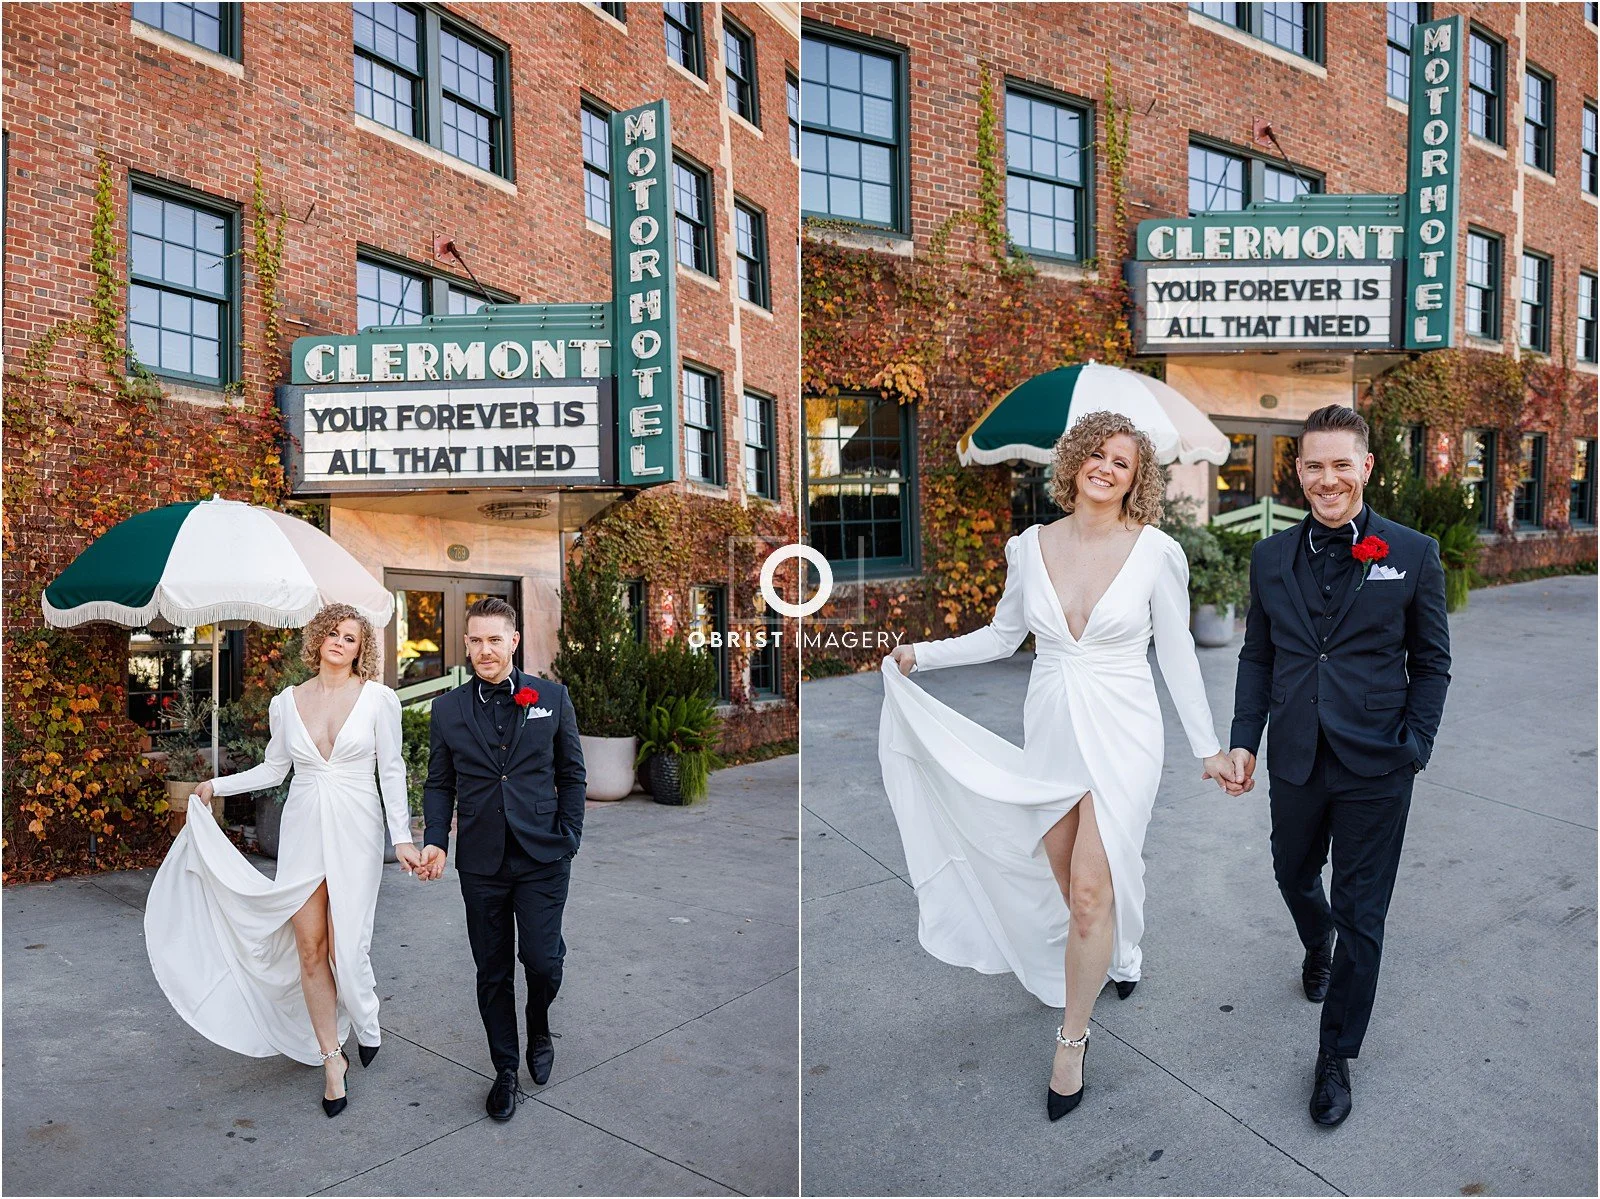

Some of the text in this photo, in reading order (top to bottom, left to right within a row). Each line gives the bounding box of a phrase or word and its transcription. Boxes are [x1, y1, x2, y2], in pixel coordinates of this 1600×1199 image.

[1147, 225, 1404, 260] CLERMONT
[1152, 278, 1379, 303] YOUR FOREVER IS
[1166, 315, 1370, 339] ALL THAT I NEED
[303, 339, 612, 383] CLERMONT
[309, 401, 586, 434] YOUR FOREVER IS
[327, 445, 576, 475] ALL THAT I NEED
[454, 547, 466, 560] 789
